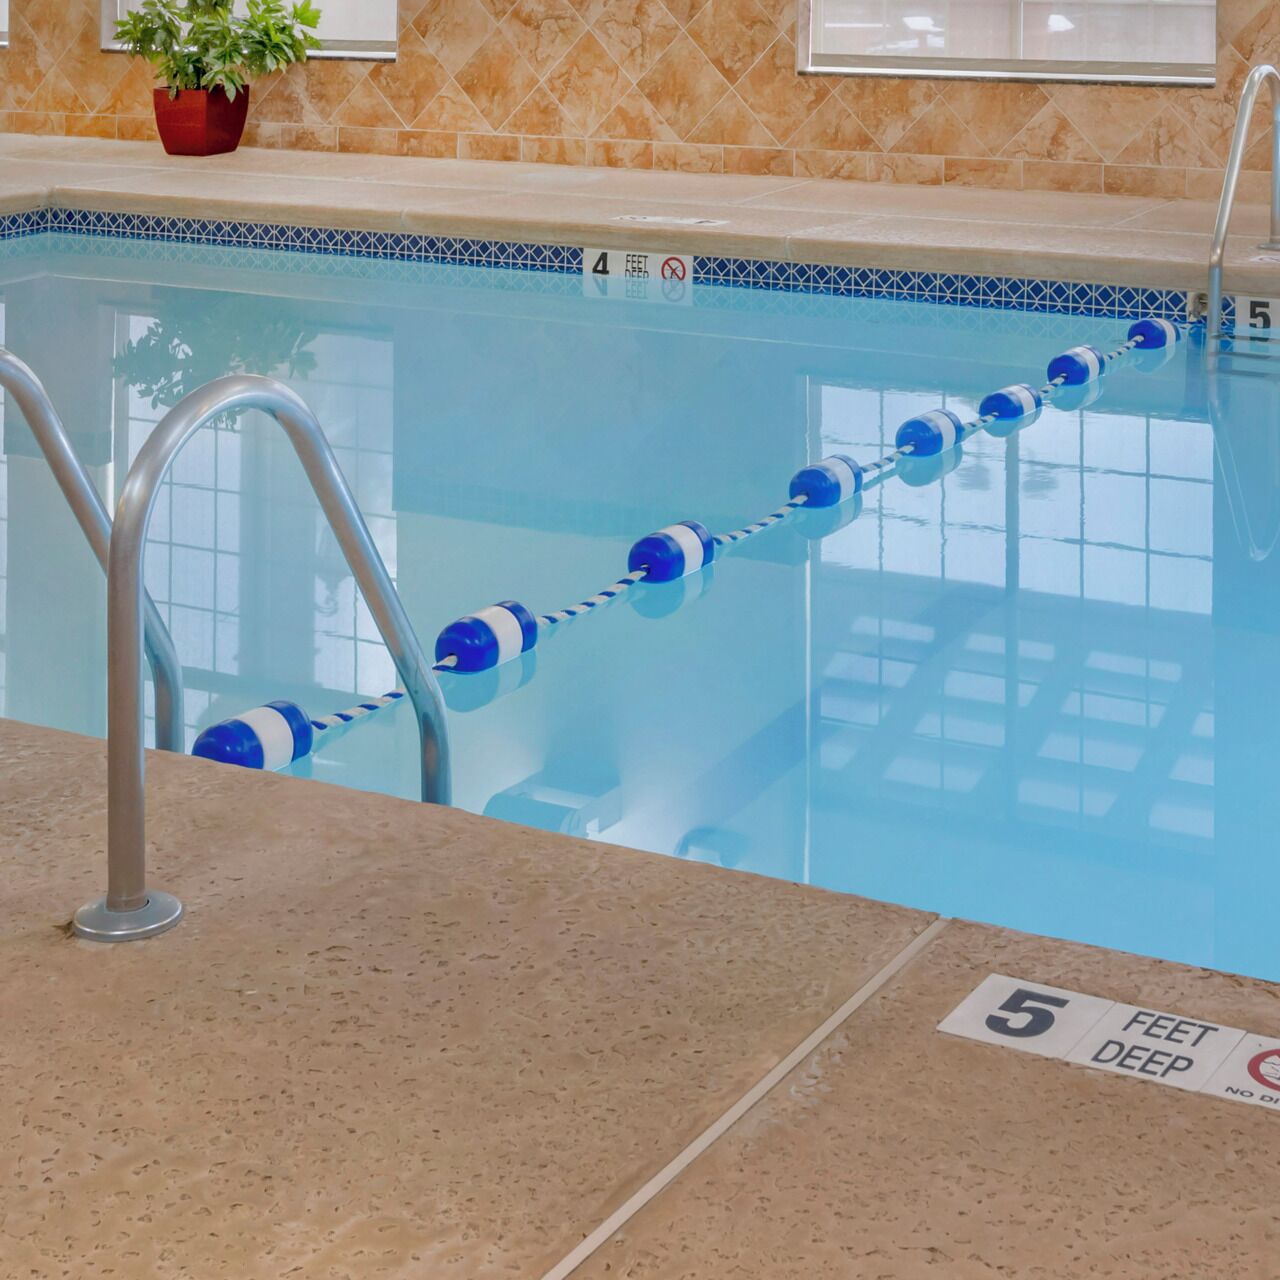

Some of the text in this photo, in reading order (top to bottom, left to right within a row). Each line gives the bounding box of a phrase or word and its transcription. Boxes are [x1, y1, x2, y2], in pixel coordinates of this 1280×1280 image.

[592, 252, 609, 275] 4
[625, 254, 648, 270] FEET
[1249, 300, 1271, 329] 5
[985, 988, 1070, 1038] 5
[1122, 1010, 1219, 1048] FEET
[1091, 1039, 1194, 1078] DEEP
[1225, 1086, 1254, 1098] NO
